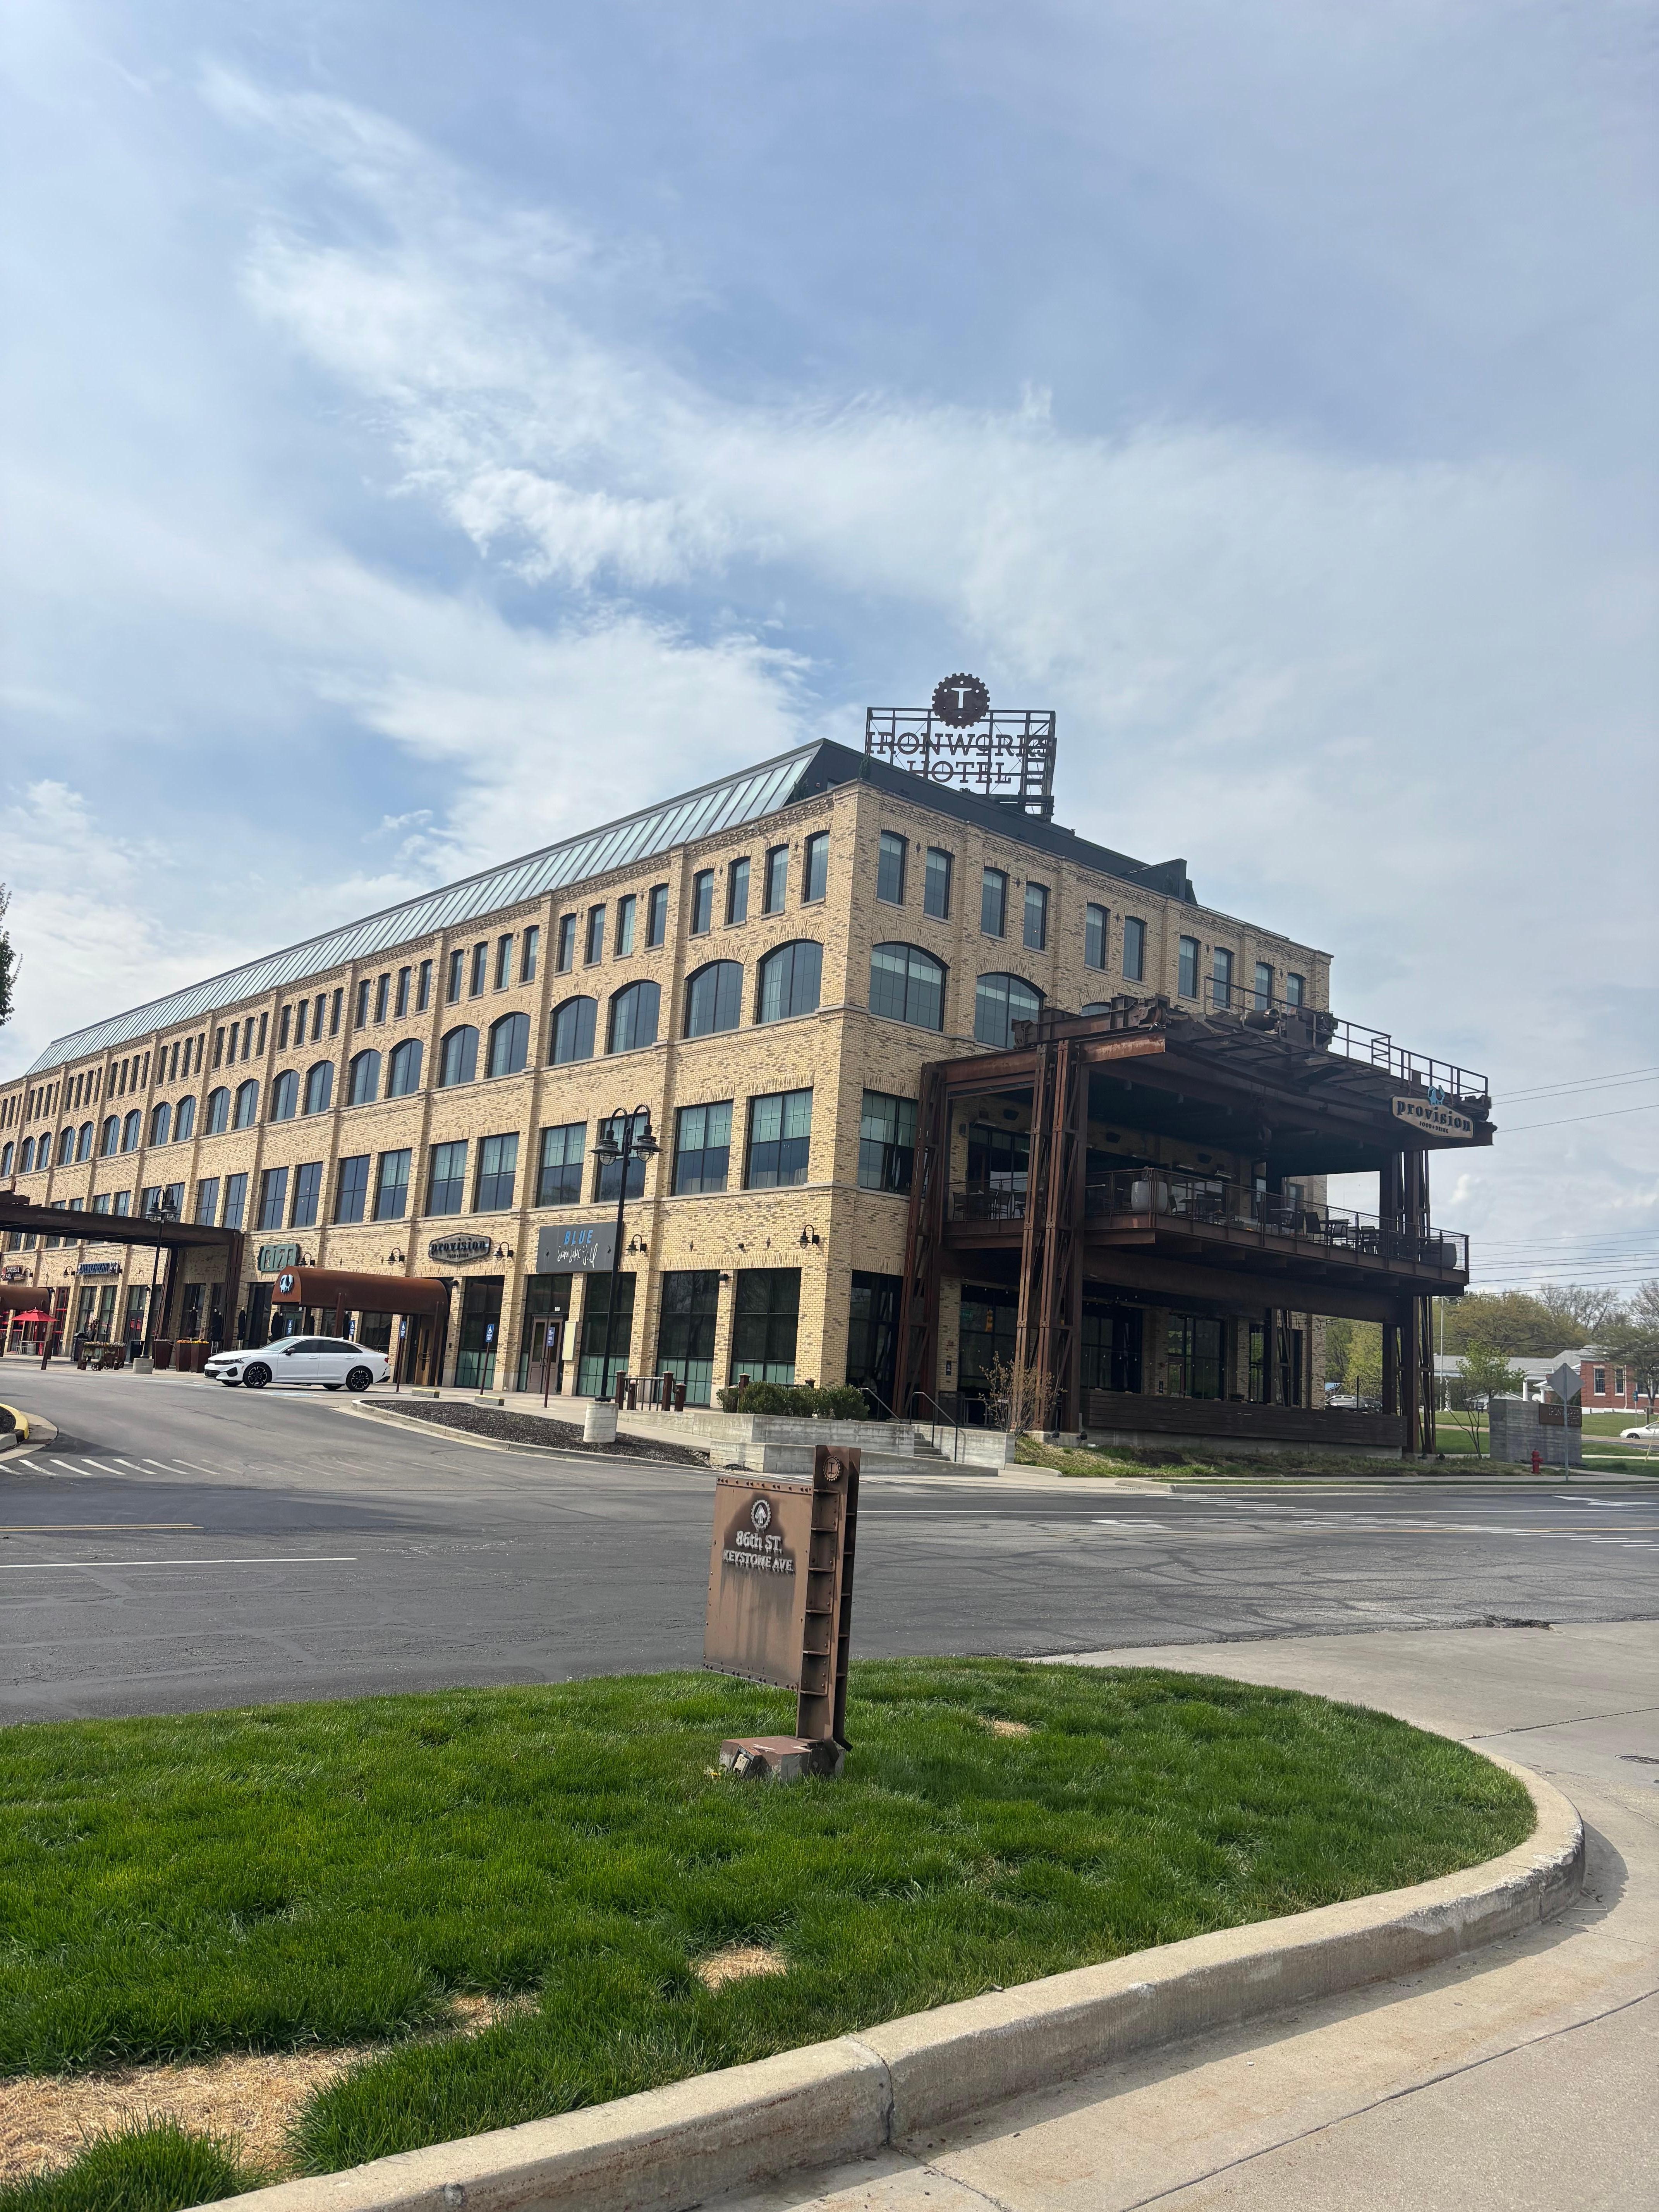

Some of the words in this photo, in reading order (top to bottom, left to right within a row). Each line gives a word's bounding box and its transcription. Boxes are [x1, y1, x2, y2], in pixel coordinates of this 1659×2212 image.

[866, 732, 1053, 758] IRONWORKS
[907, 760, 1011, 784] HOTEL
[564, 1230, 593, 1245] BLUE
[736, 1530, 763, 1551] 86th
[764, 1535, 782, 1553] ST.
[723, 1549, 772, 1568] KEYSTONE
